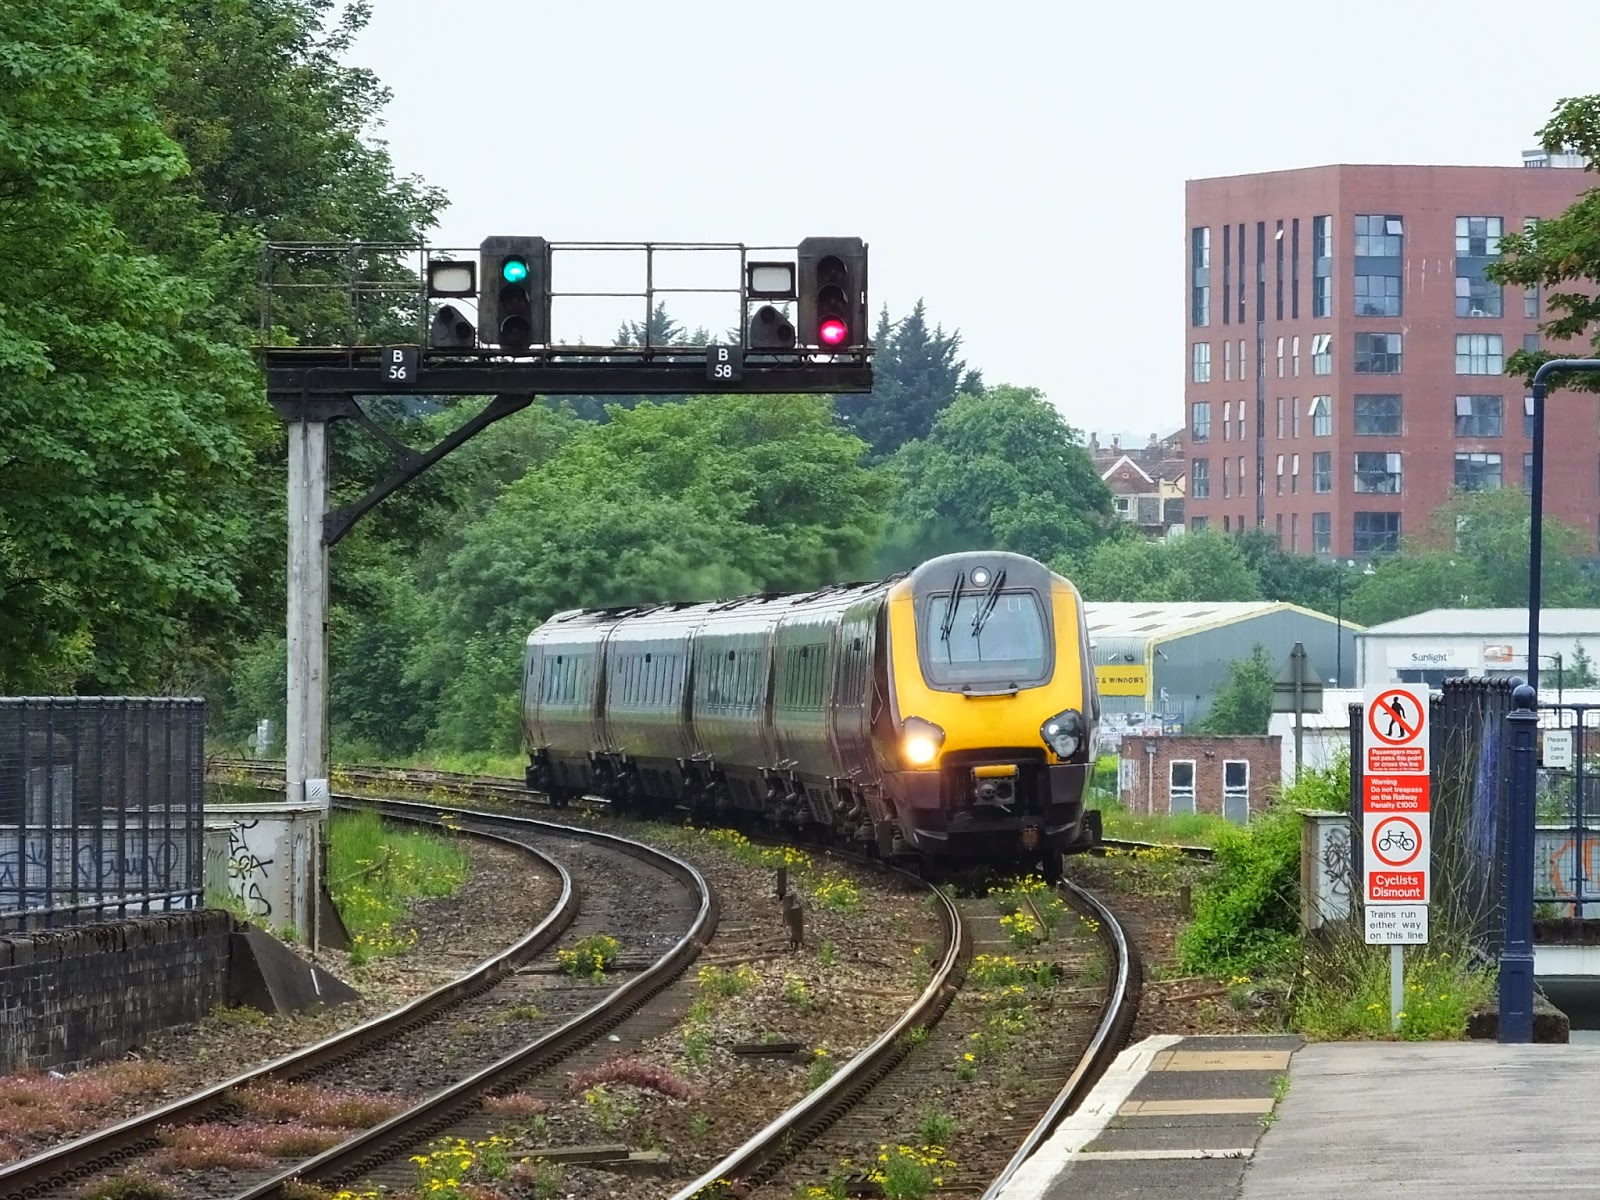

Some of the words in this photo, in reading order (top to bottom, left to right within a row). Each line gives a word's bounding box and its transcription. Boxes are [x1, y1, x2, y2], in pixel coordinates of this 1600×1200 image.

[393, 350, 403, 363] B
[718, 348, 729, 361] B
[388, 365, 406, 379] 56
[714, 364, 732, 378] 58
[1412, 653, 1447, 663] Sunlight
[1376, 875, 1418, 887] Cyclists
[1373, 887, 1420, 897] Dismount
